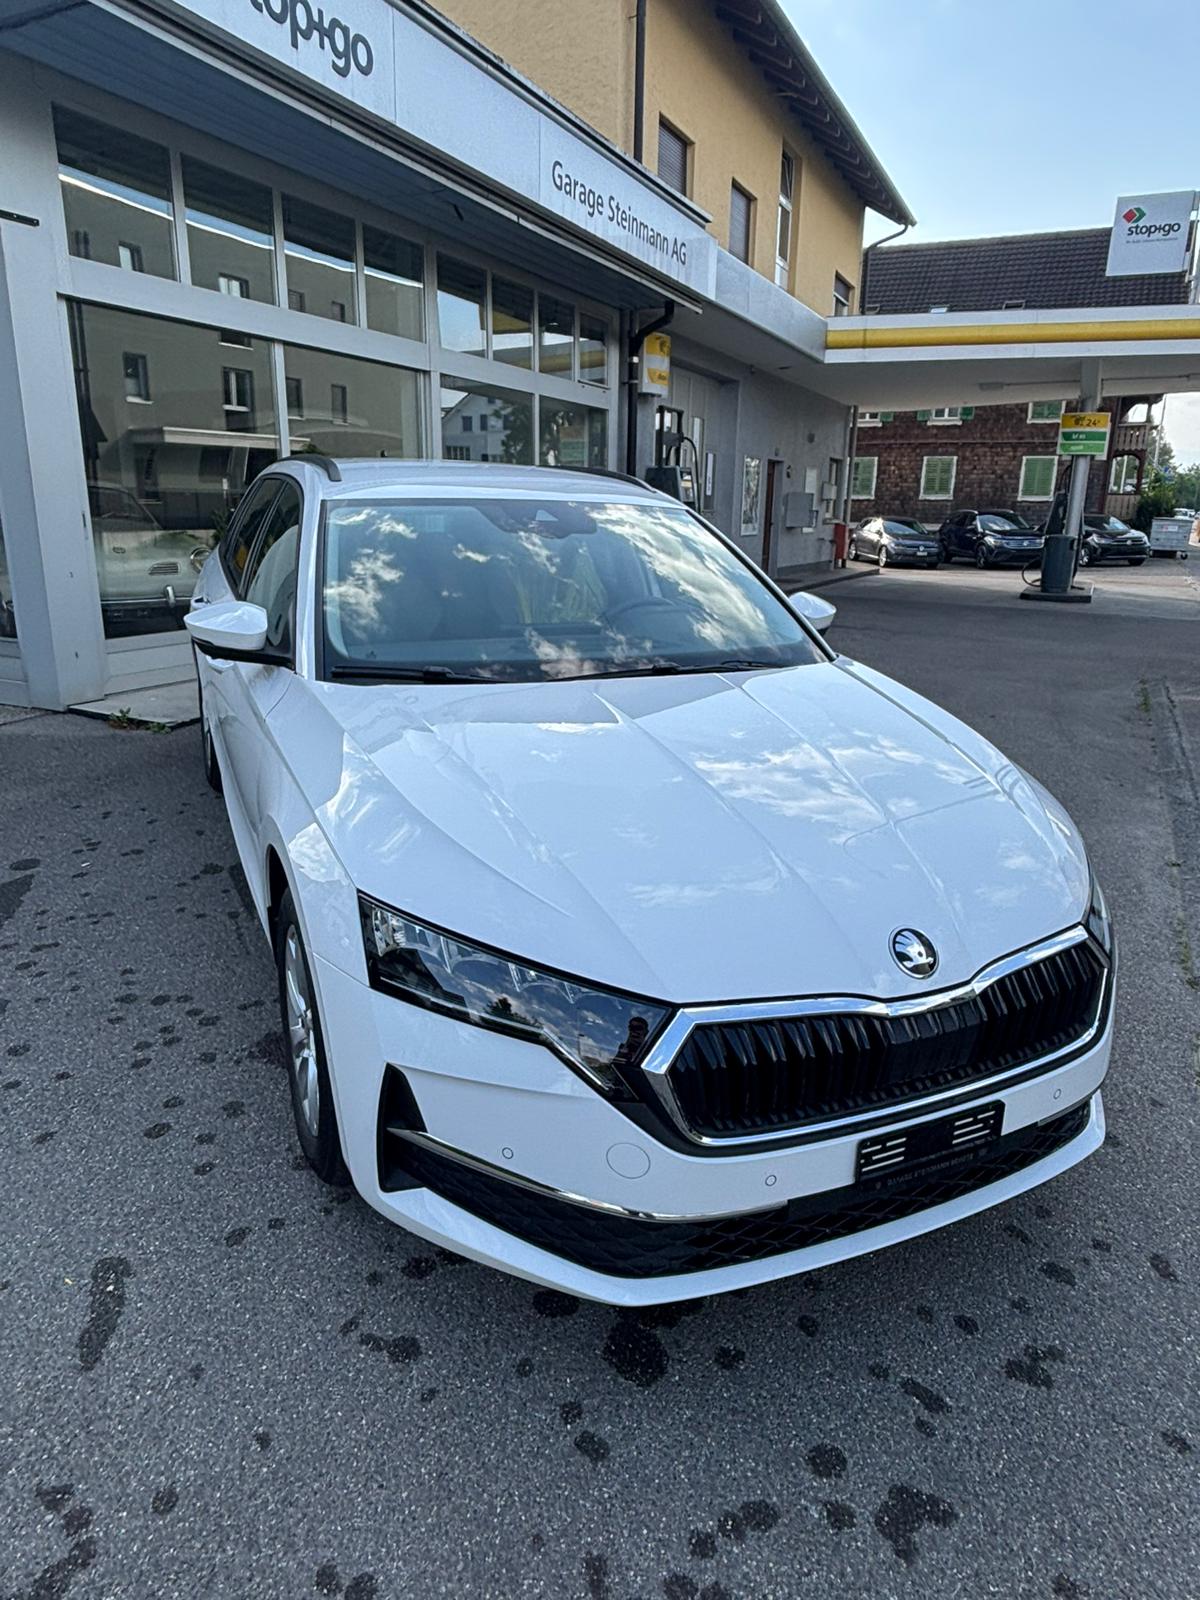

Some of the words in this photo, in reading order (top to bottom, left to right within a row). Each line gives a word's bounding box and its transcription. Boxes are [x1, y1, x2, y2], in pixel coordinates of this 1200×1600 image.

[552, 160, 604, 218] Garage
[608, 195, 669, 255] Steinmann
[671, 237, 687, 266] AG
[1127, 222, 1181, 238] stop+go
